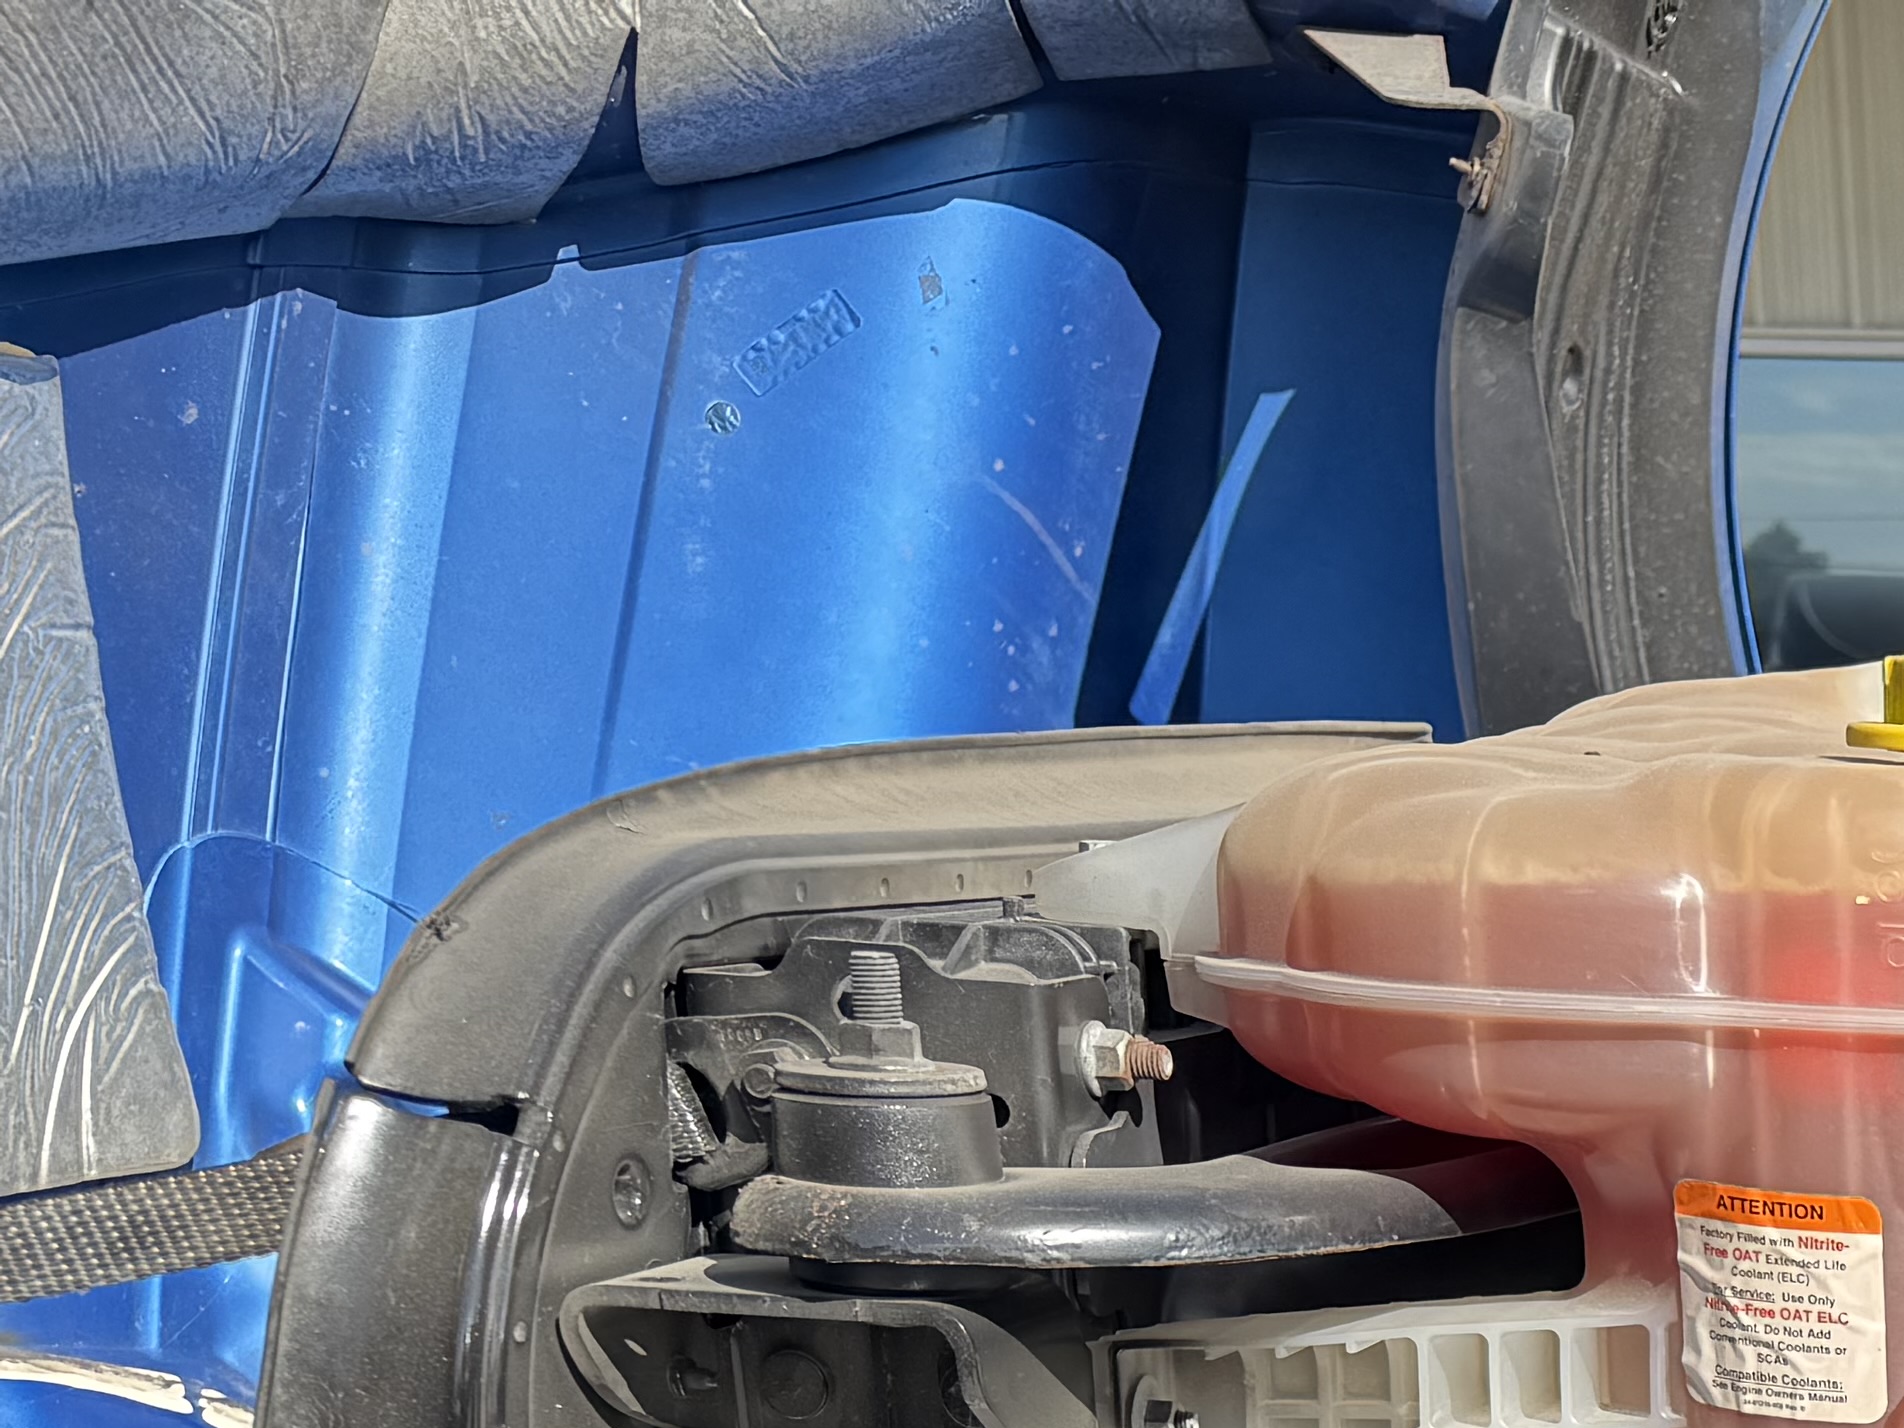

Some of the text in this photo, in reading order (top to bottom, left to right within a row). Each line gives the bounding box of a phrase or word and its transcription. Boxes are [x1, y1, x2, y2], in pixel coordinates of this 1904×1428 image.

[1716, 1194, 1824, 1221] ATTENTION
[1700, 1225, 1734, 1243] Factory
[1737, 1231, 1766, 1247] Filled
[1769, 1236, 1794, 1249] with
[1703, 1242, 1729, 1259] Free
[1732, 1247, 1762, 1263] OAT
[1765, 1253, 1820, 1270] Extended
[1731, 1266, 1810, 1286] Coolant (ELC)
[1730, 1286, 1776, 1302] Service:
[1782, 1292, 1804, 1305] Use
[1807, 1293, 1835, 1309] Only
[1780, 1307, 1814, 1323] OAT
[1816, 1310, 1849, 1325] ELC
[1709, 1330, 1847, 1356] Conventional Coolants or
[1764, 1322, 1780, 1336] Do
[1782, 1324, 1804, 1338] Not
[1807, 1327, 1832, 1340] Add
[1757, 1352, 1788, 1367] SCAs
[1714, 1364, 1843, 1390] Compatible Coolants:
[1712, 1378, 1728, 1391] See
[1731, 1381, 1763, 1398] Engine
[1808, 1391, 1848, 1404] Manual
